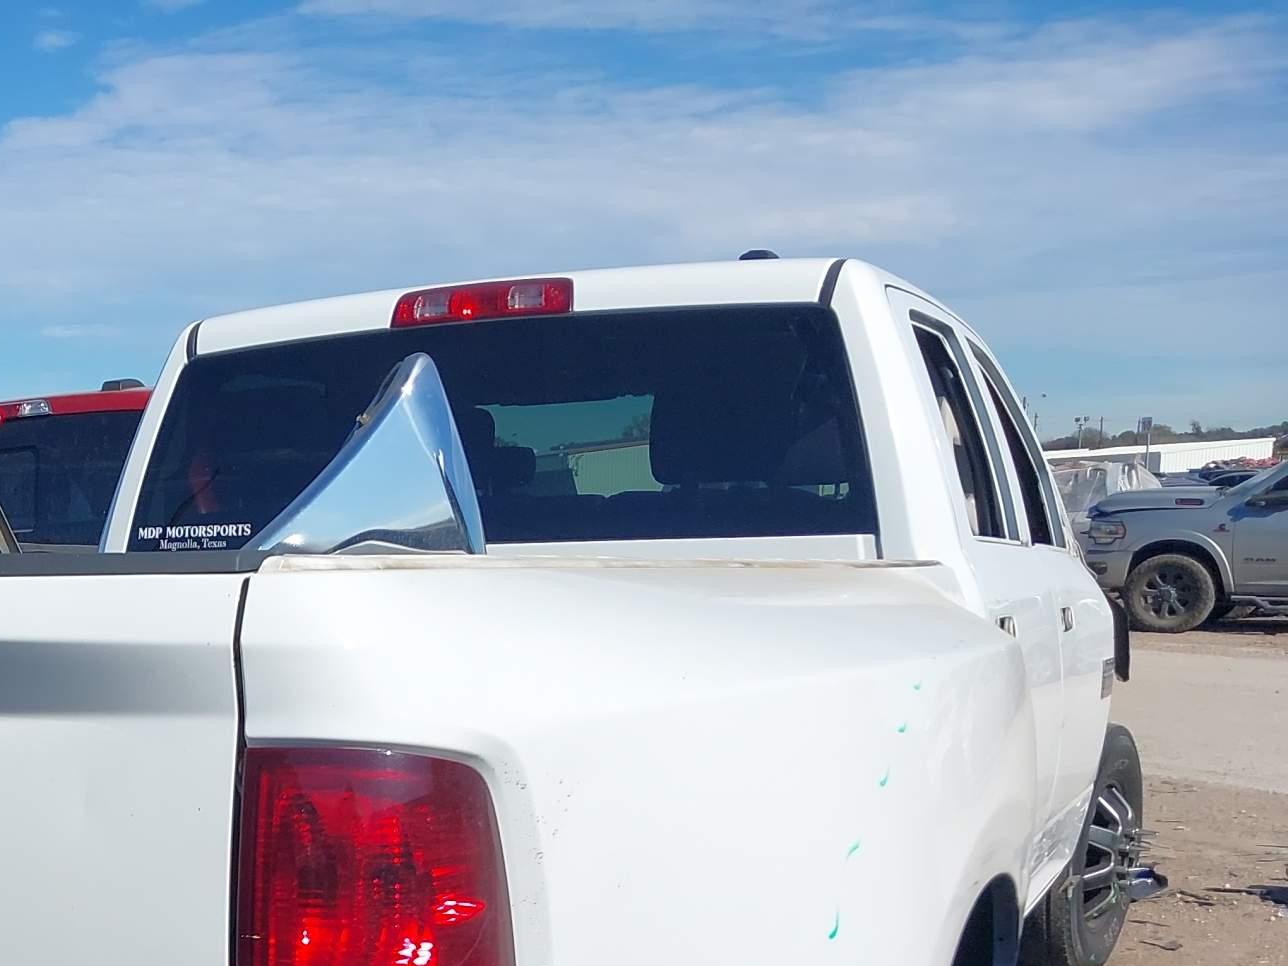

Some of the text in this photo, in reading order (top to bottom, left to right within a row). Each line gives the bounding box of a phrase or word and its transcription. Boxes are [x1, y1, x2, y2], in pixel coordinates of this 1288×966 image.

[138, 523, 252, 539] MDP MOTORSPORTS
[159, 538, 227, 551] Magnolia, Texas
